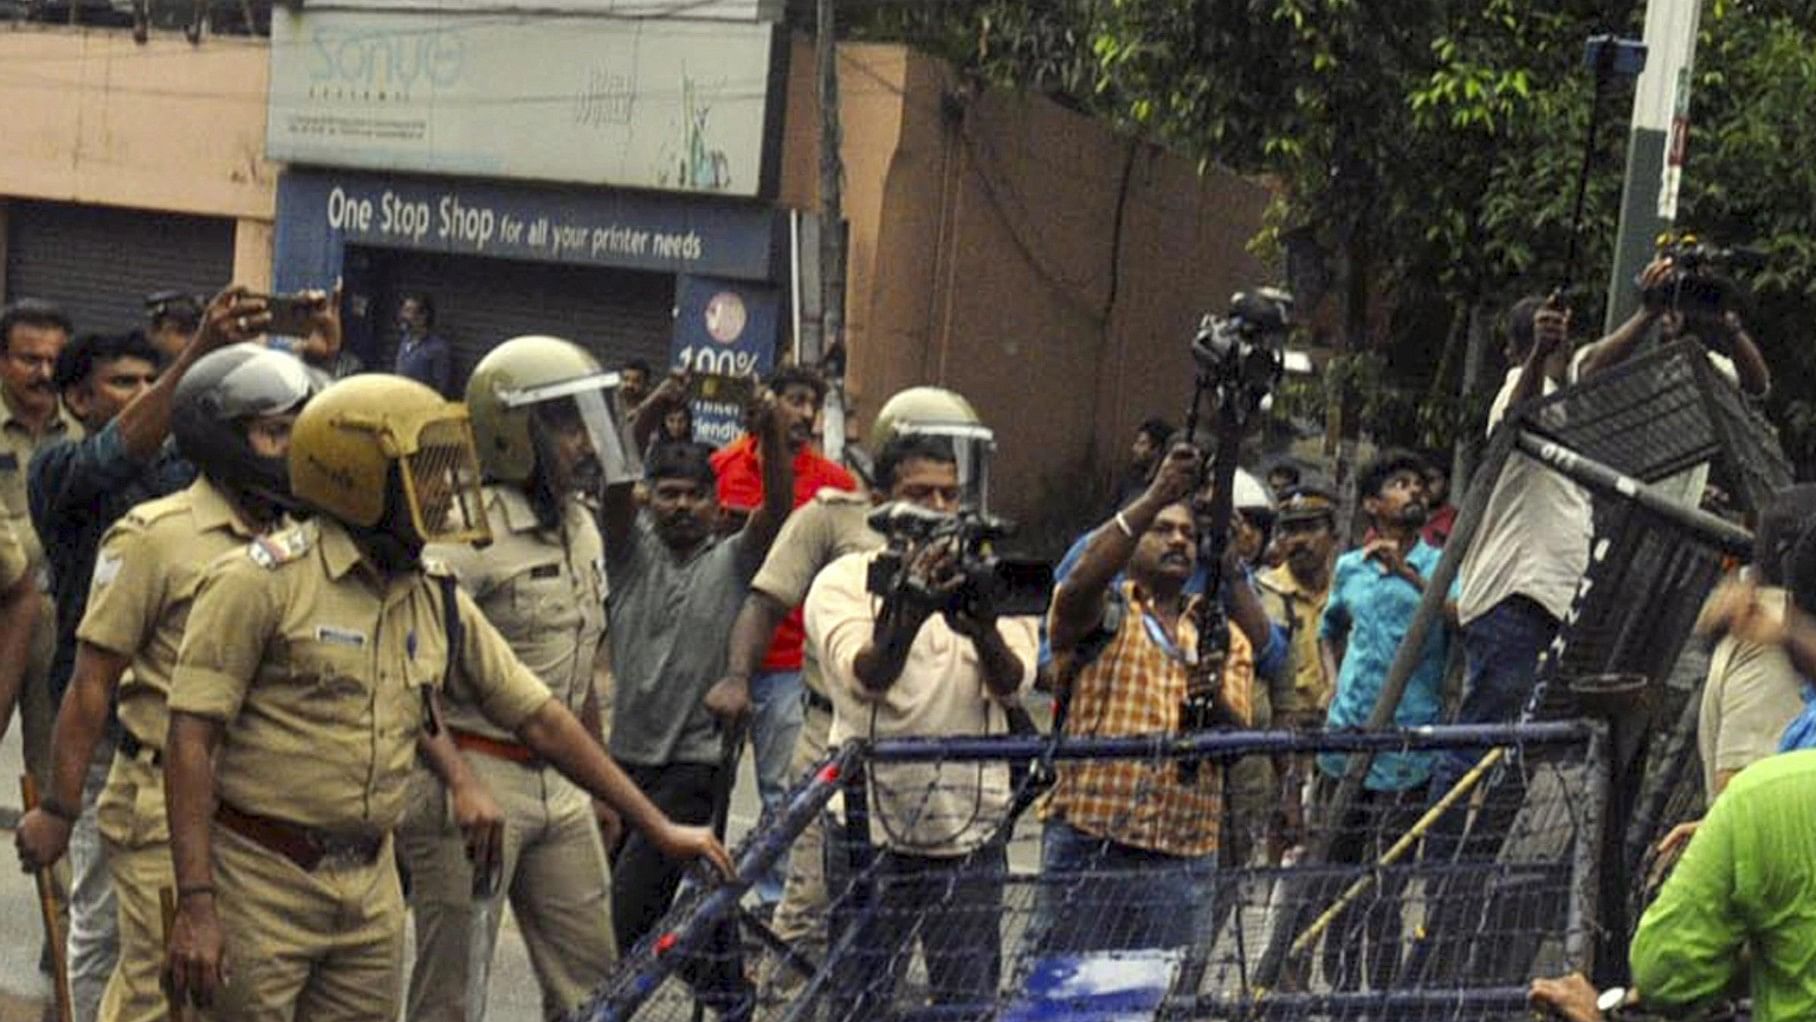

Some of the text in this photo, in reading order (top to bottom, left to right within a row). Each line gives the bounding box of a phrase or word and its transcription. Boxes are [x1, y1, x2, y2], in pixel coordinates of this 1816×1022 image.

[327, 186, 701, 260] One Stop Shop for all your printer needs
